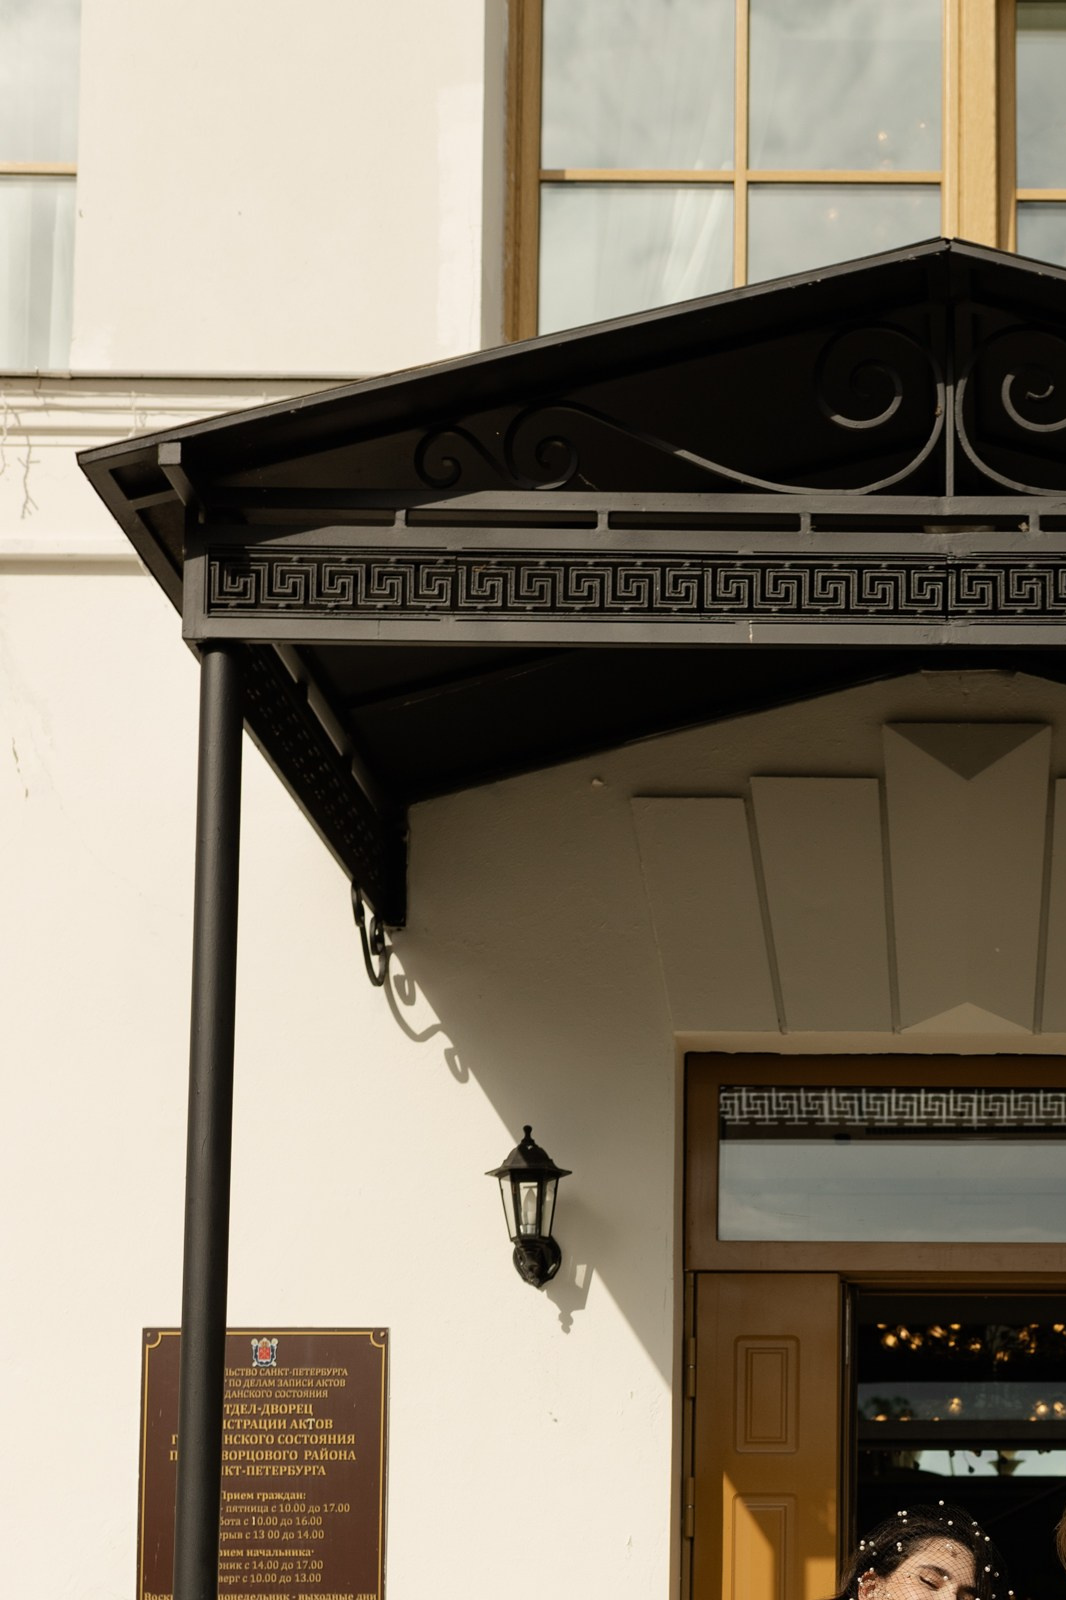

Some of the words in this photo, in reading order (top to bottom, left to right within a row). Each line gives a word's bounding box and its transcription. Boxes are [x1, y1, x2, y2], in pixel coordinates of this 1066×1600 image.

[259, 1368, 348, 1377] САНКТ-ПЕТЕРБУРГА
[229, 1379, 241, 1388] ПО
[243, 1379, 275, 1389] ДЕЛАМ
[278, 1379, 314, 1388] ЗАПИСИ
[316, 1379, 346, 1387] АКТОВ
[224, 1390, 272, 1400] ДАНСКОГО
[275, 1390, 328, 1398] СОСТОЯНИЯ
[224, 1404, 313, 1416] ТДЕЛ-ДВОРЕЦ
[223, 1419, 287, 1431] СТРАЦИИ
[290, 1418, 333, 1430] АКТОВ
[278, 1434, 355, 1445] СОСТОЯНИЯ
[304, 1447, 356, 1461] РАЙОНА
[221, 1465, 326, 1476] КТ-ПЕТЕРБУРГА
[256, 1492, 306, 1502] граждан:
[226, 1505, 269, 1514] пятница
[271, 1505, 277, 1513] с
[279, 1503, 306, 1513] 10.00
[308, 1505, 320, 1514] до
[323, 1503, 350, 1513] 17.00
[243, 1518, 249, 1526] с
[252, 1516, 278, 1526] 10.00
[280, 1518, 293, 1527] до
[295, 1516, 323, 1526] 16.00
[282, 1532, 295, 1541] до
[297, 1530, 325, 1539] 14.00
[244, 1562, 250, 1570] с
[252, 1561, 279, 1570] 14.00
[280, 1562, 294, 1571] до
[296, 1561, 324, 1570] 17.00
[242, 1575, 248, 1583] с
[250, 1573, 277, 1583] 10.00
[279, 1575, 292, 1584] до
[294, 1573, 322, 1583] 13.00
